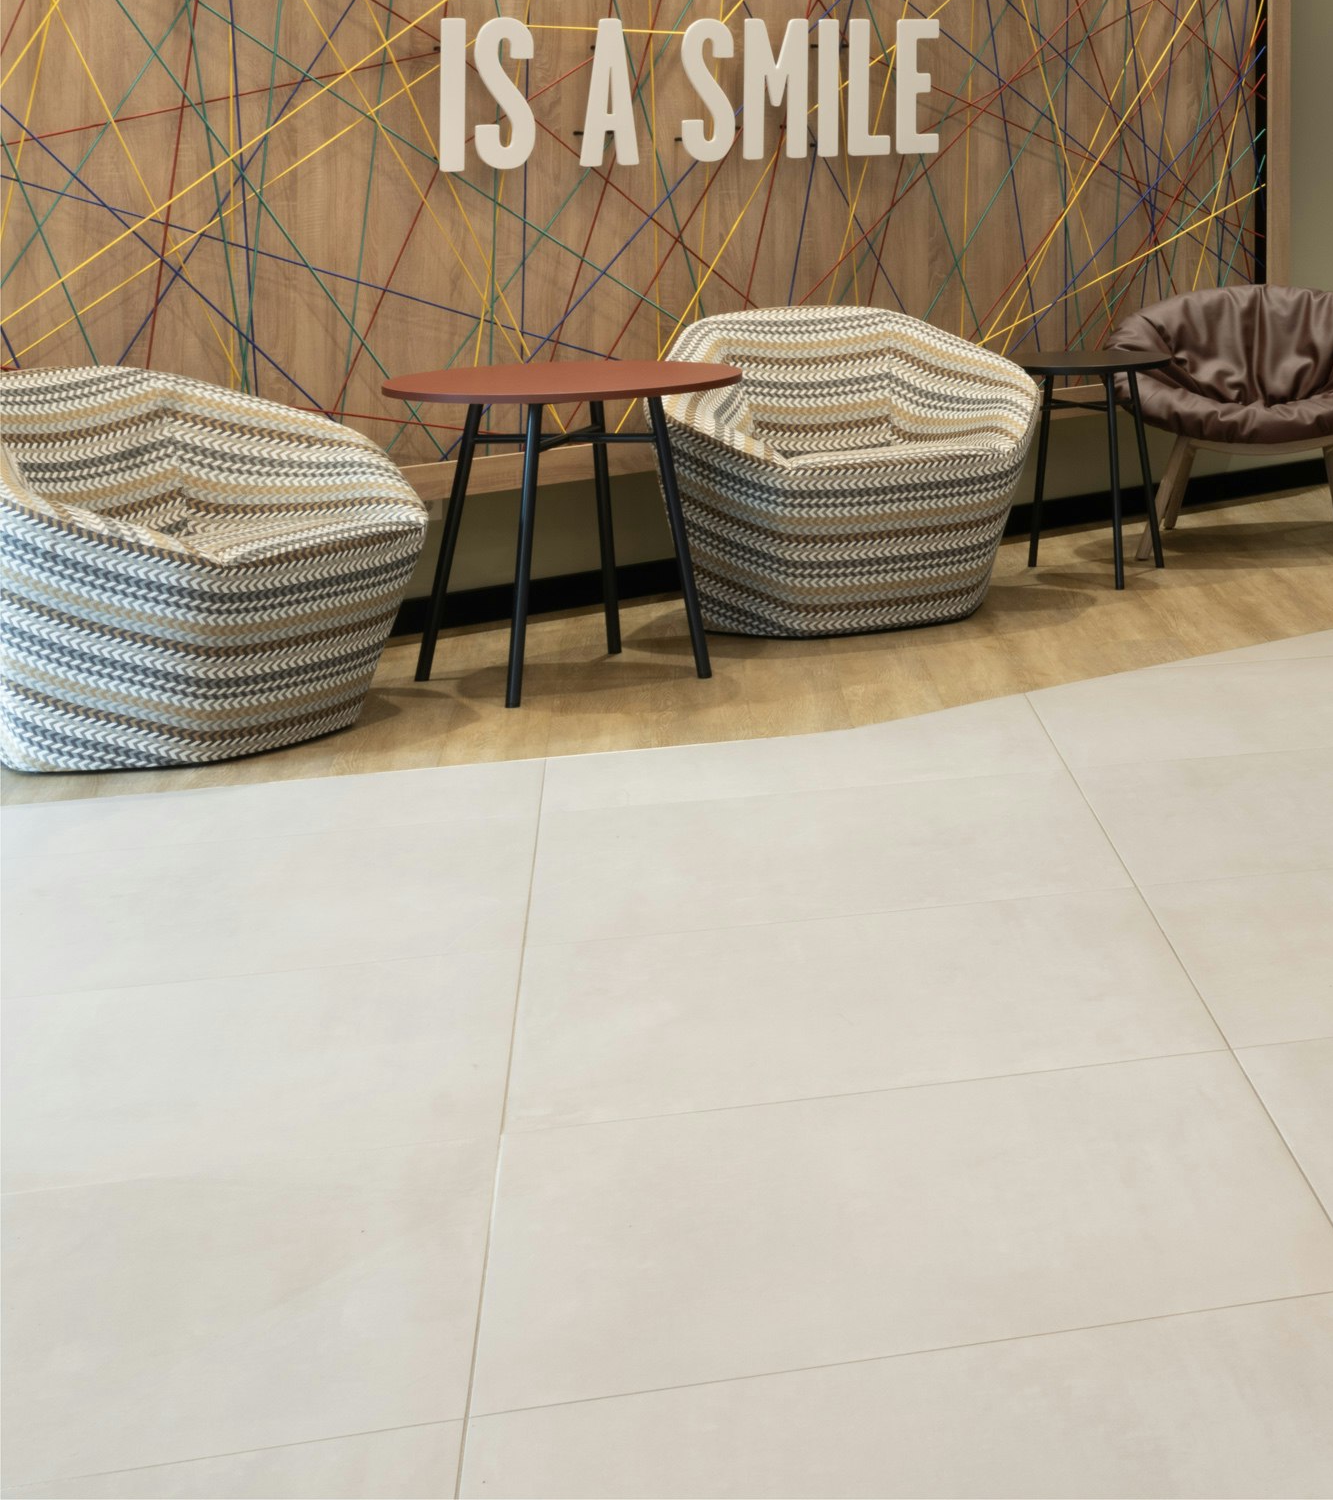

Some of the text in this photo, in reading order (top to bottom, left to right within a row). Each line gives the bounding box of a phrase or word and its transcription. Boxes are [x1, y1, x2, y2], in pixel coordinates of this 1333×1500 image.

[438, 16, 941, 173] IS A SMILE
